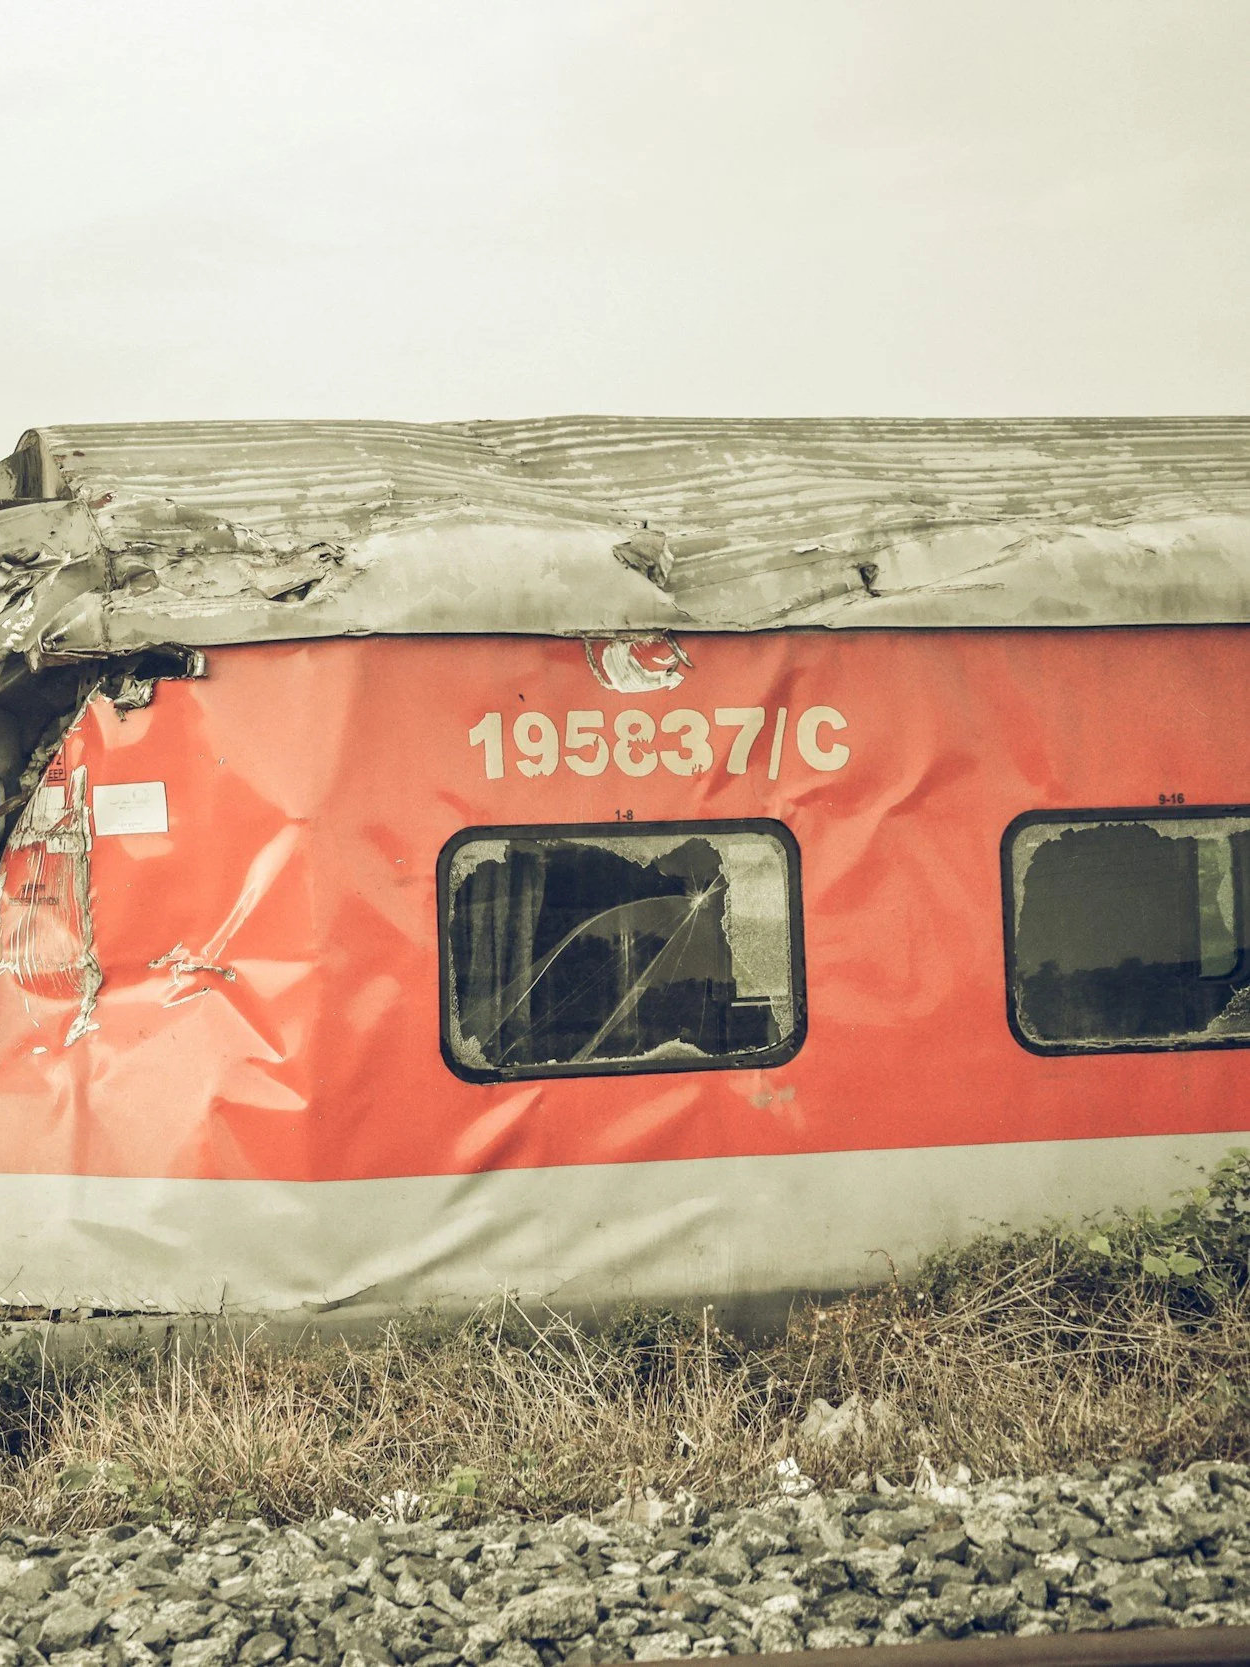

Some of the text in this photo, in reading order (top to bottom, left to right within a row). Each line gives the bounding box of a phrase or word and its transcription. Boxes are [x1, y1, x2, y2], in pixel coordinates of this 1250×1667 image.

[468, 705, 850, 781] 195837/C
[1159, 793, 1185, 804] 9-16
[615, 809, 633, 821] 1-8
